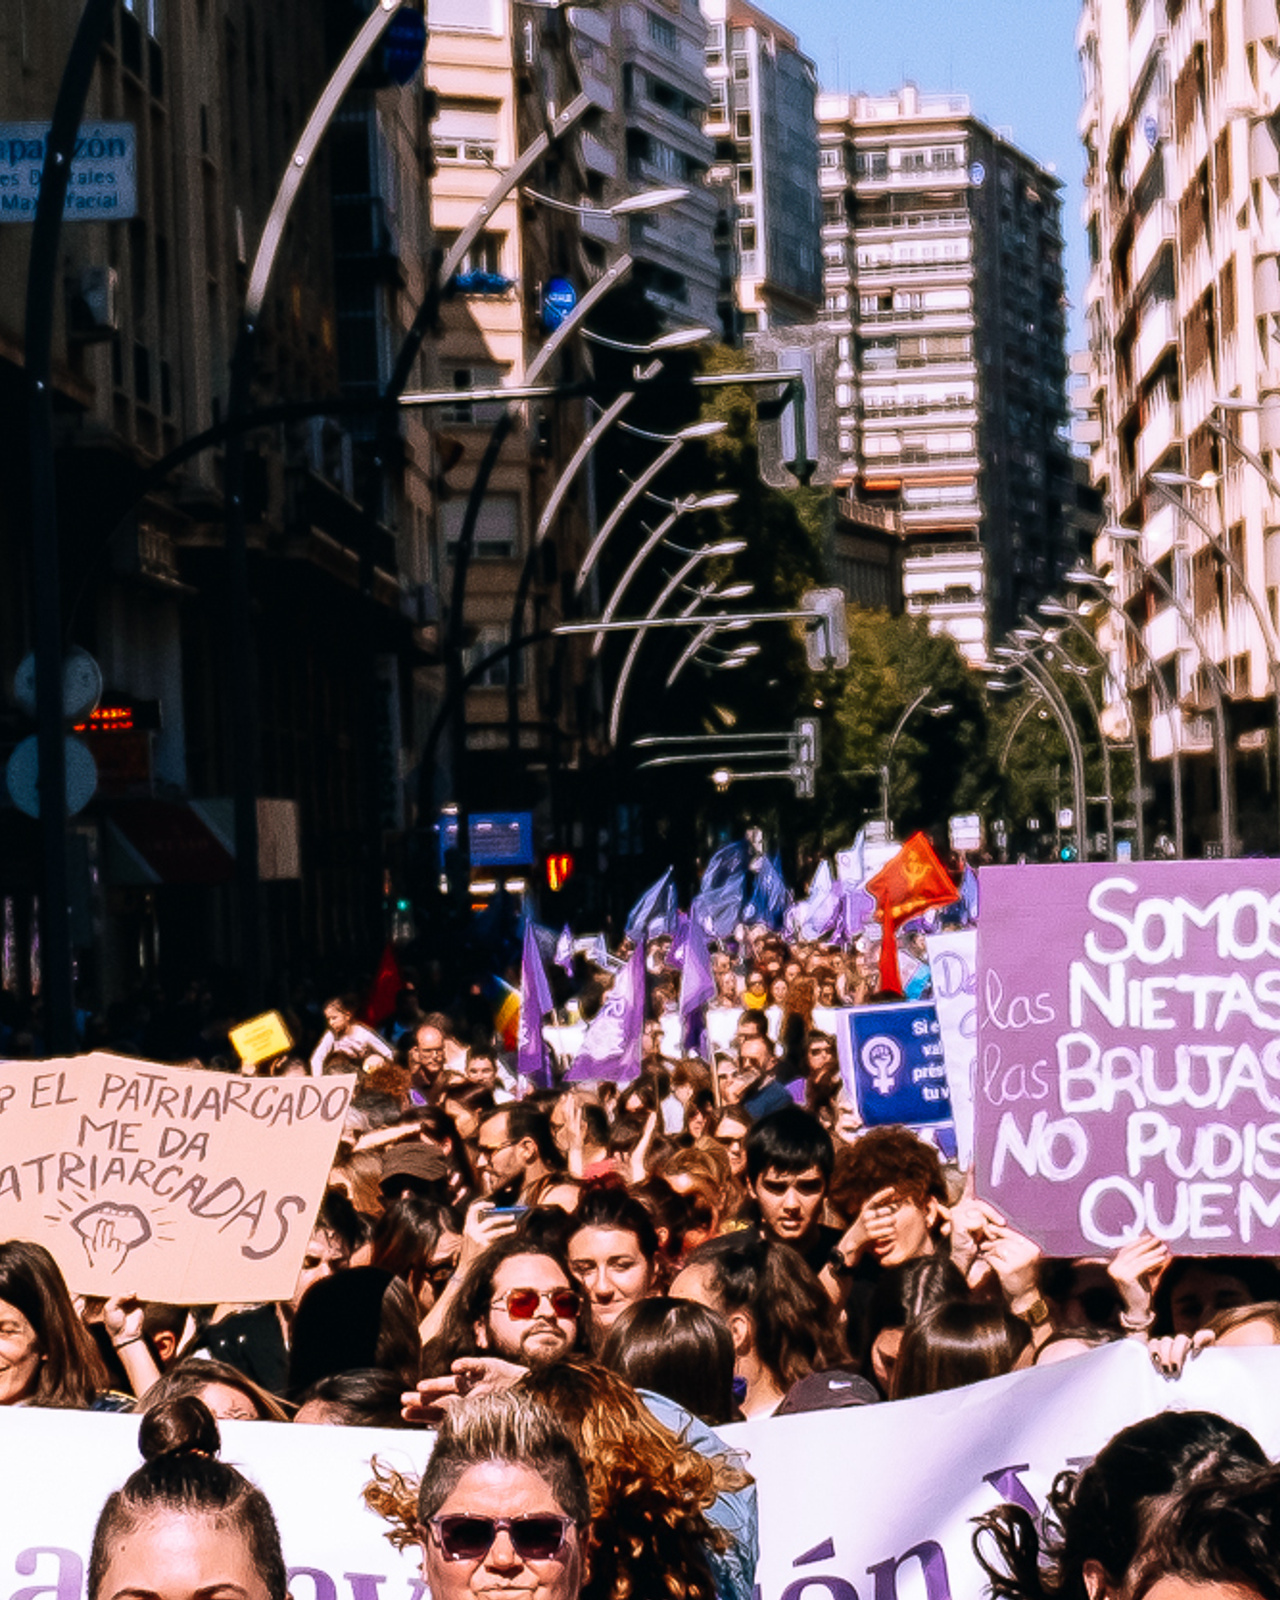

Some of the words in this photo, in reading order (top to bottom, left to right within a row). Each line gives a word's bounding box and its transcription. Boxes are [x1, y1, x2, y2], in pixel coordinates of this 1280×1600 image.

[983, 968, 1055, 1030] las
[31, 1073, 77, 1109] EL
[99, 1072, 350, 1126] PATRIARCADO
[984, 1043, 1050, 1106] las
[77, 1114, 144, 1152] ME
[159, 1126, 209, 1160] DA
[991, 1111, 1088, 1187] NO
